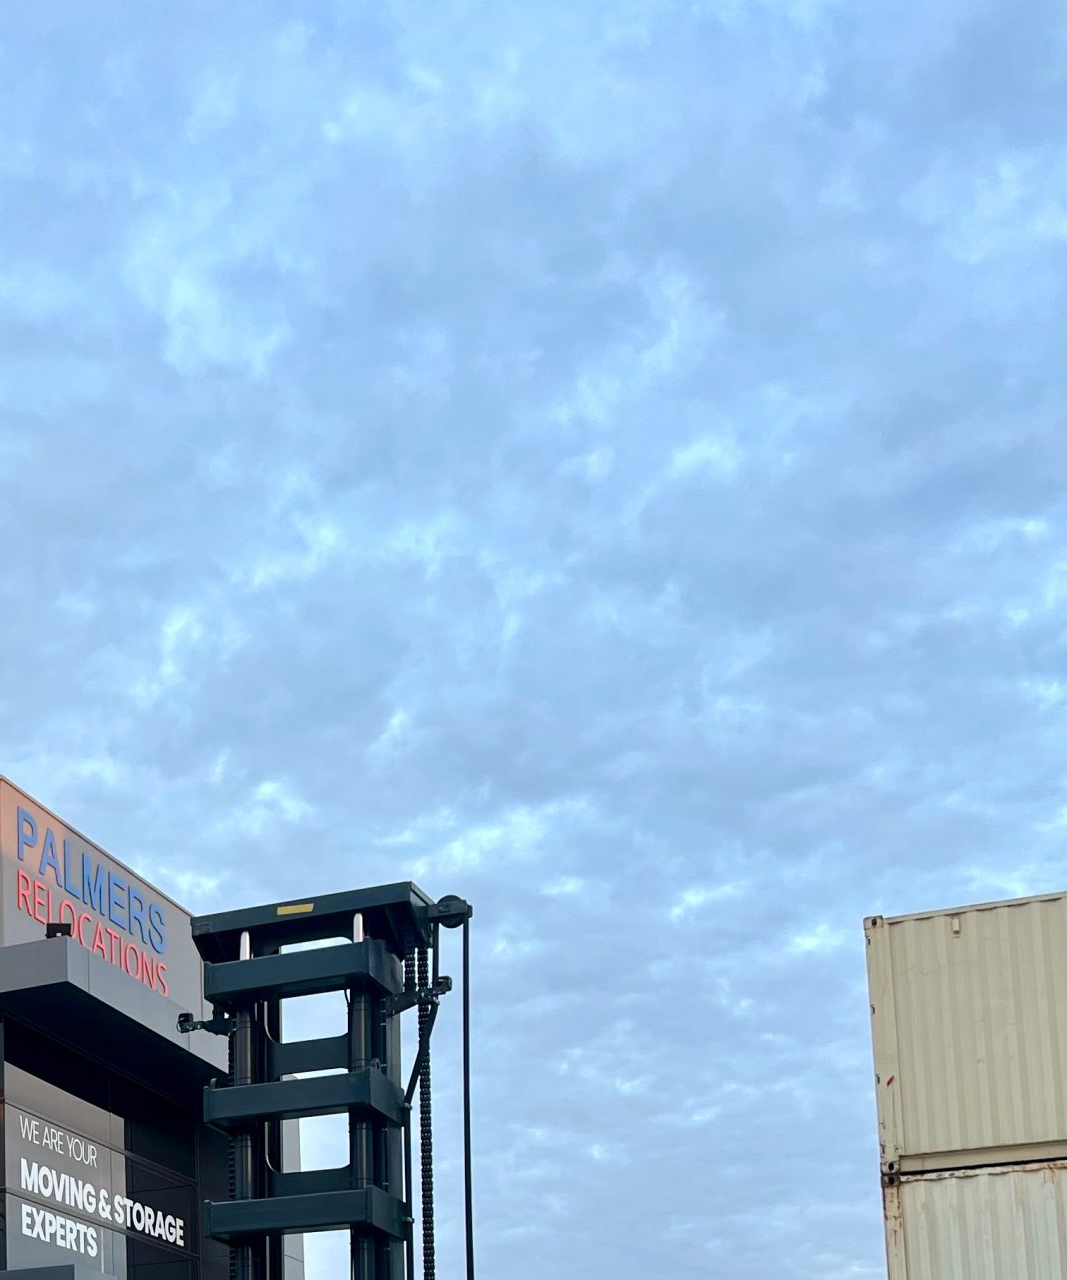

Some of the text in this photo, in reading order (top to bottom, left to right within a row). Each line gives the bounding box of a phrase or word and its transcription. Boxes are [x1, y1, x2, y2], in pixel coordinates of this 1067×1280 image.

[17, 806, 166, 954] PALMERS
[17, 868, 169, 997] RELOCATIONS
[19, 1114, 98, 1169] WE ARE YOUR
[20, 1157, 185, 1247] MOVING & STORAGE
[21, 1203, 98, 1258] EXPERTS
